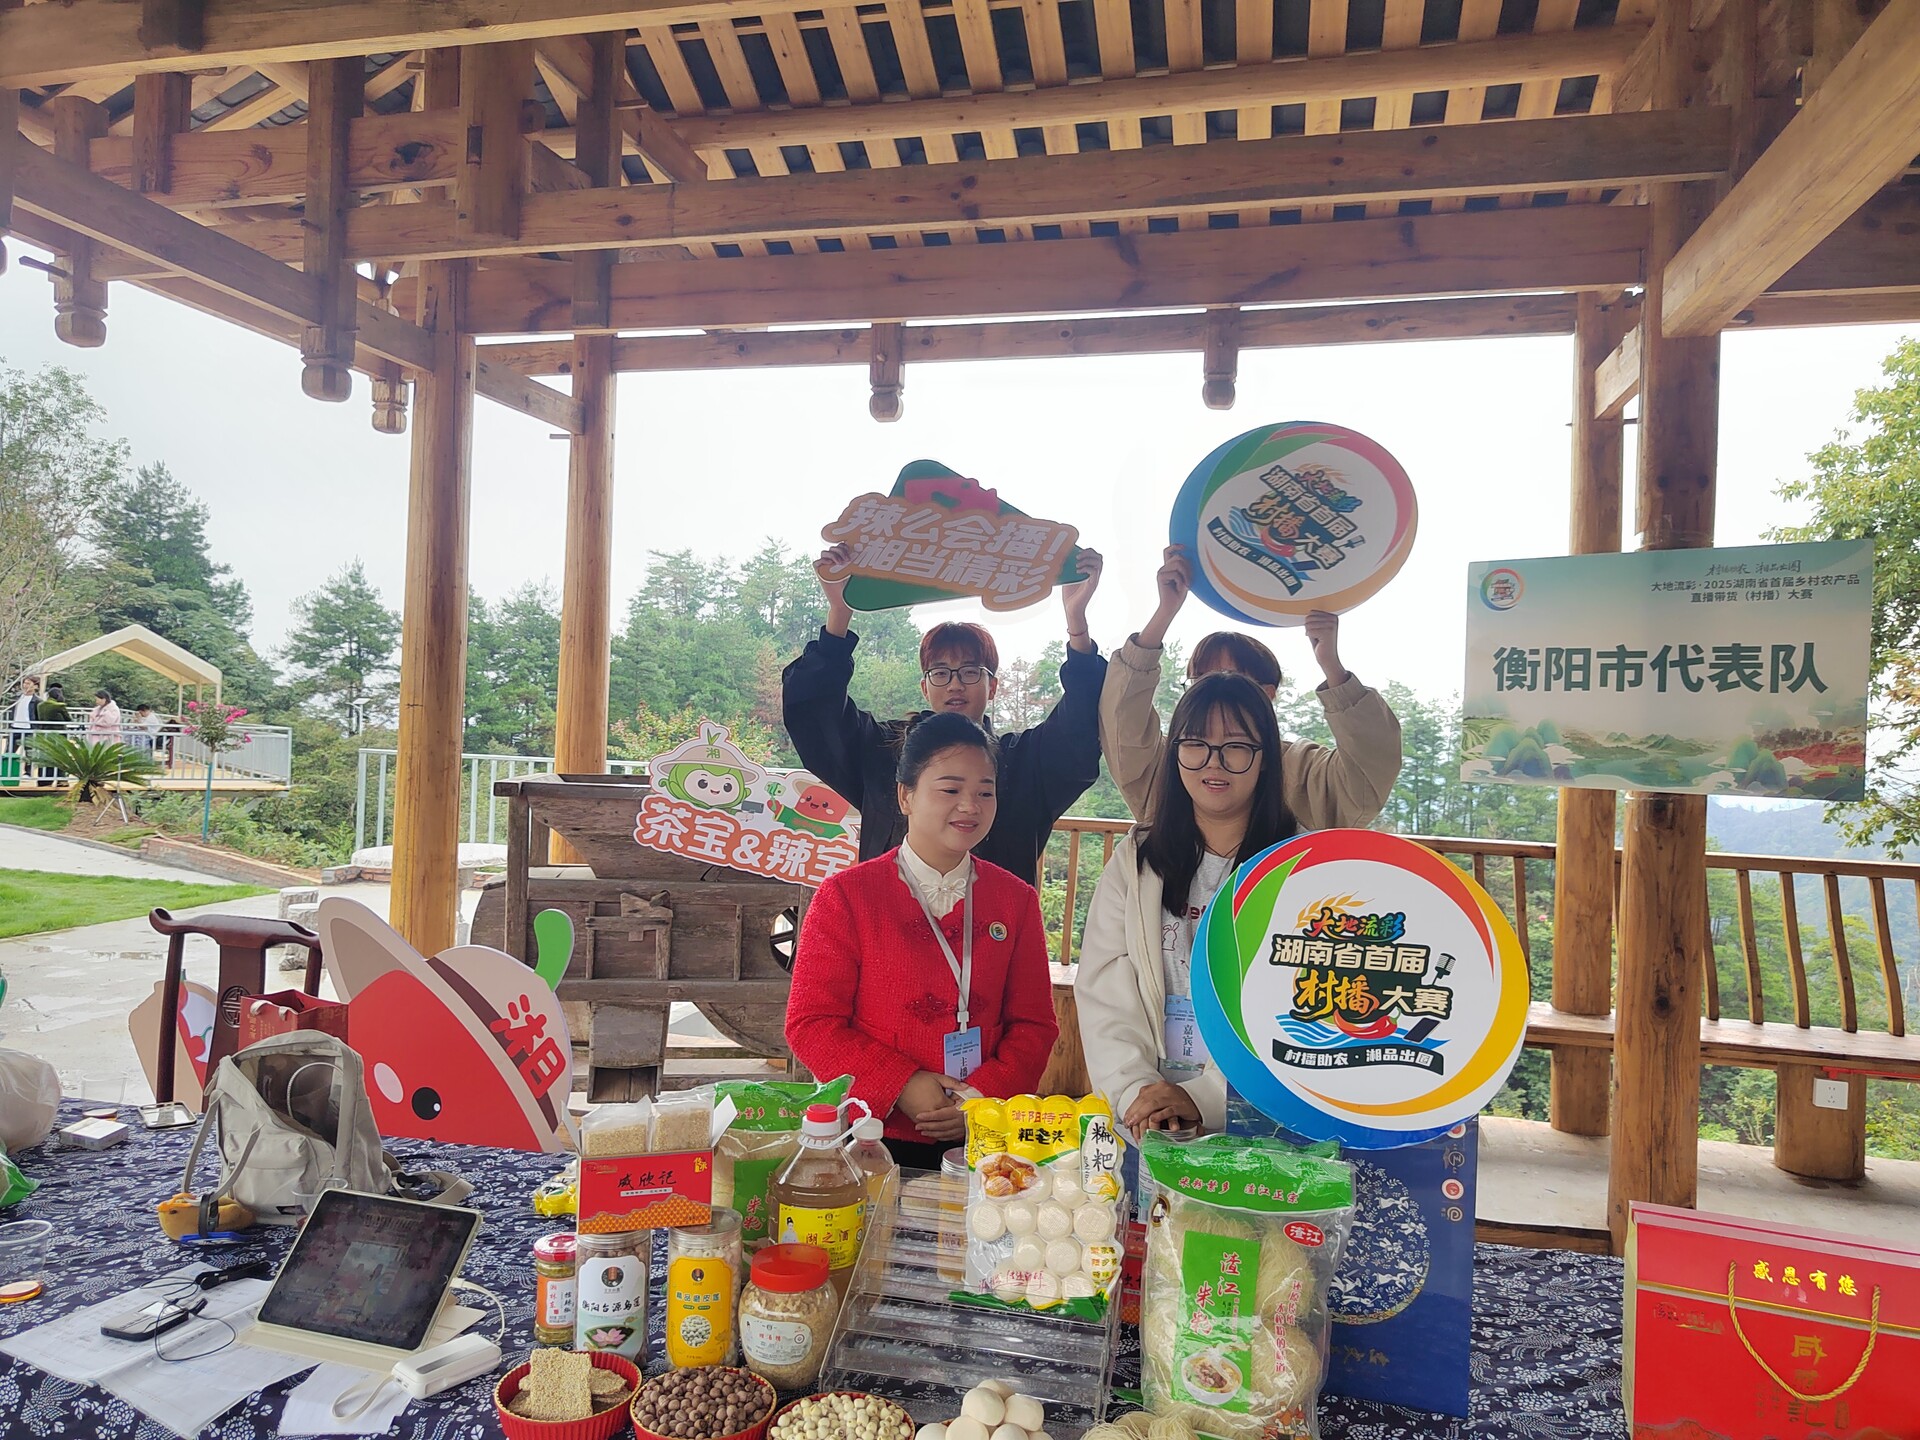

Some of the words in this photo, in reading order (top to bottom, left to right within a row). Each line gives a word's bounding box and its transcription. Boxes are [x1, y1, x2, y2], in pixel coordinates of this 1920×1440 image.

[1263, 466, 1354, 538] 湖南省首届
[829, 534, 1050, 603] 湘当精彩
[1492, 642, 1829, 694] 衡阳市代表队
[643, 801, 856, 883] 茶宝&辣宝
[1311, 909, 1405, 938] 大地流彩
[1272, 937, 1428, 974] 湖南省首届
[490, 993, 567, 1099] 湘
[1182, 1024, 1194, 1057] 嘉宾证
[1011, 1110, 1074, 1125] 衡阳特产
[1244, 1183, 1300, 1205] 渣江正宗
[1290, 1225, 1321, 1244] 渣江
[1217, 1251, 1241, 1296] 渣江
[1752, 1259, 1859, 1296] 感恩有您
